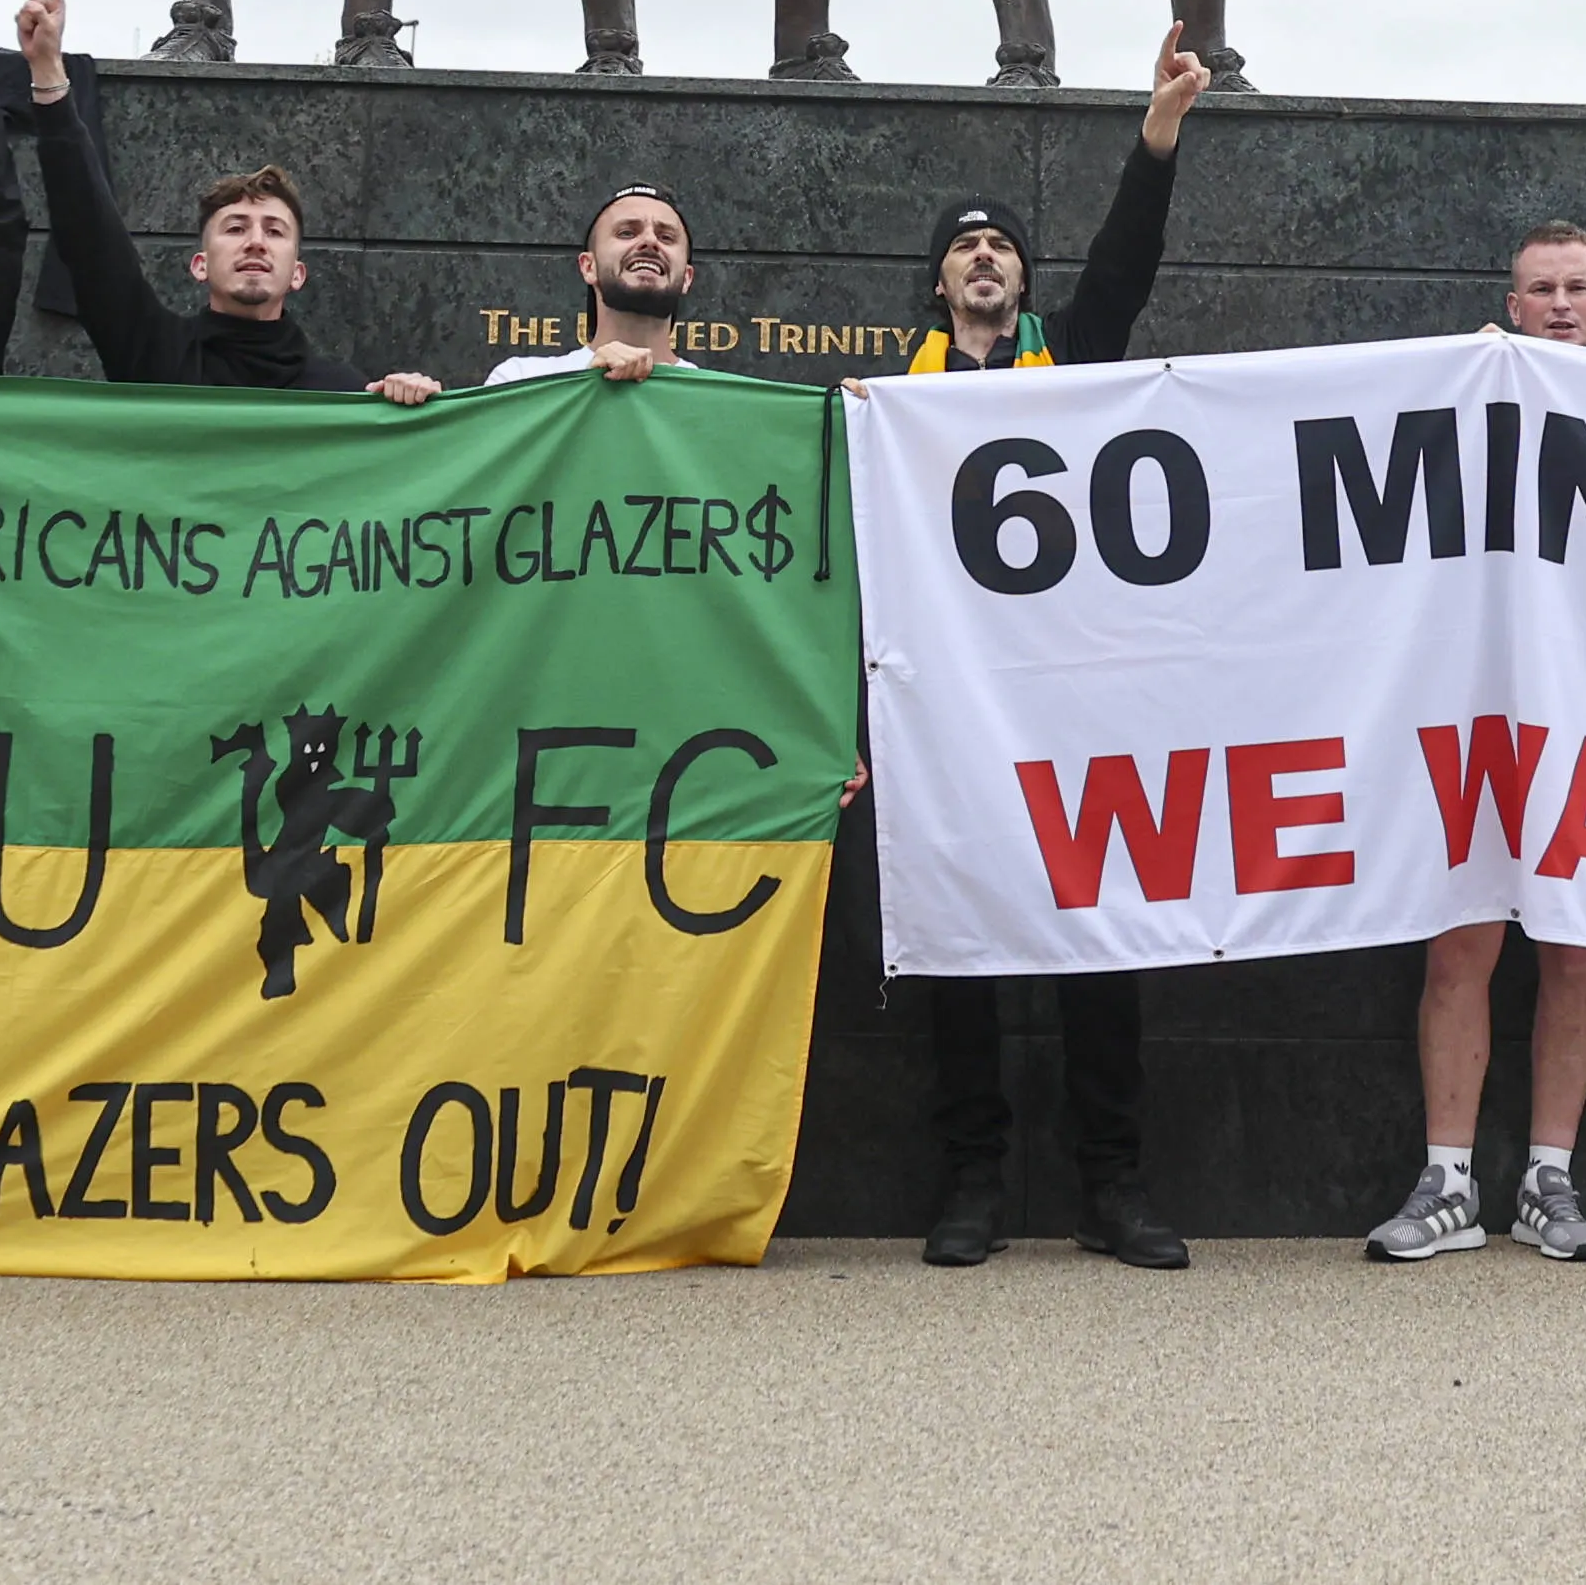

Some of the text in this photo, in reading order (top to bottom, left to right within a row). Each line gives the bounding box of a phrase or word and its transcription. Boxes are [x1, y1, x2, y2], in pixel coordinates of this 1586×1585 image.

[479, 308, 562, 346] THE
[750, 317, 917, 356] TRINITY
[243, 506, 491, 600] AGAINST
[951, 429, 1211, 595] 60
[503, 726, 783, 946] FC
[1015, 736, 1355, 910] WE
[400, 1066, 667, 1237] OUT!
